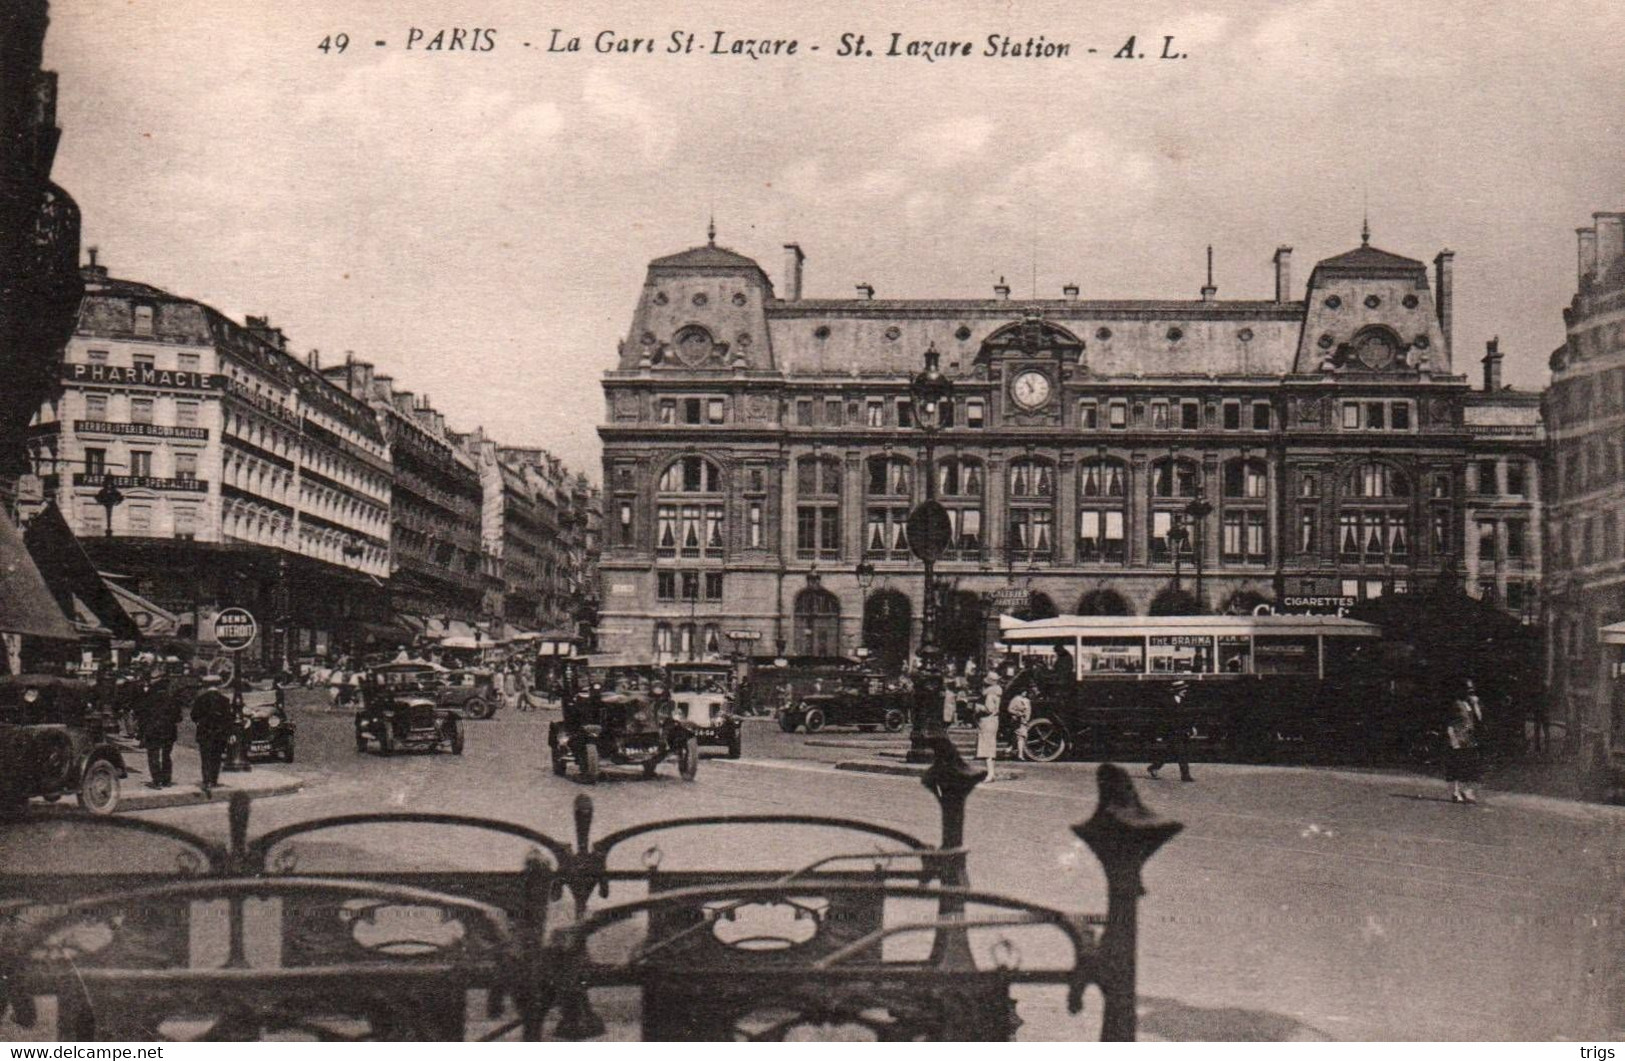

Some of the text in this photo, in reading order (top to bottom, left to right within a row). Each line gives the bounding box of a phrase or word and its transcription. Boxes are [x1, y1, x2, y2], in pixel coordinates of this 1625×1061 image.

[74, 364, 212, 389] PHARMACIE
[83, 475, 139, 487] PARFERIE
[1283, 596, 1354, 607] CIGARETTES
[221, 615, 248, 624] SENS
[216, 624, 253, 638] INTERDIT
[1151, 637, 1169, 646] THE
[1171, 635, 1212, 646] BRAHMA
